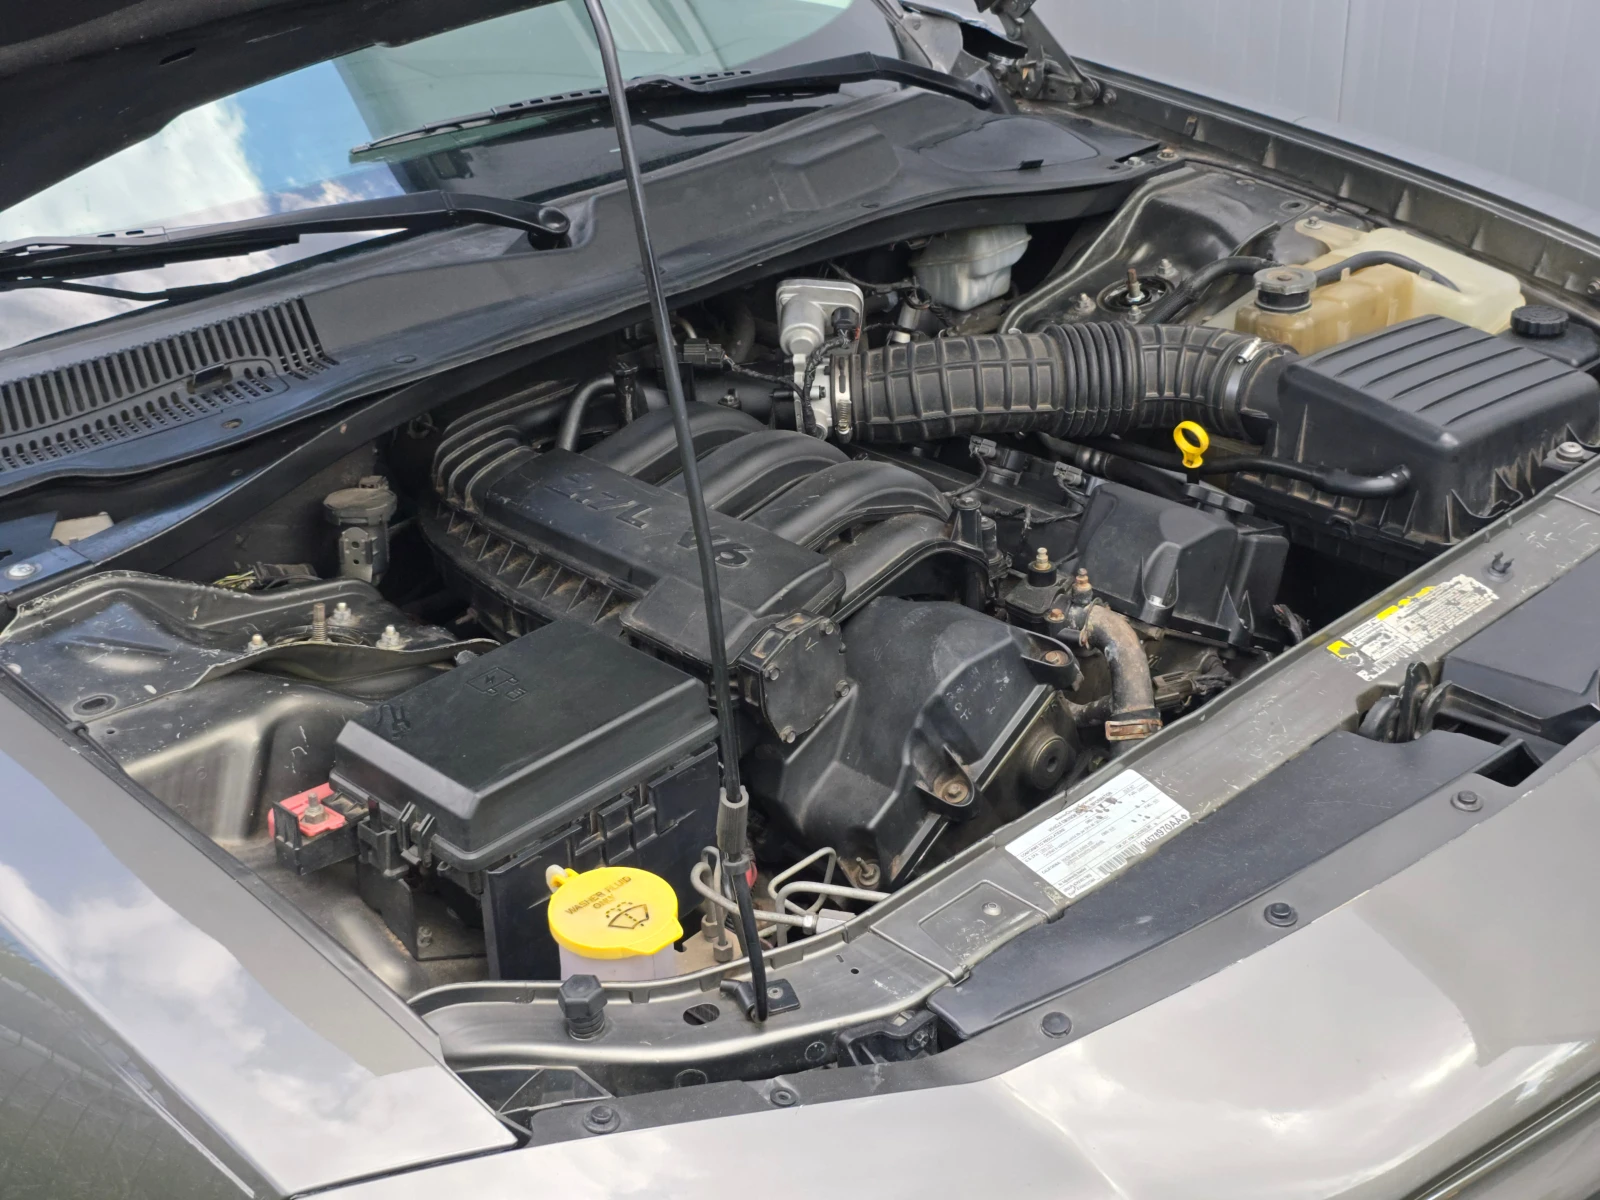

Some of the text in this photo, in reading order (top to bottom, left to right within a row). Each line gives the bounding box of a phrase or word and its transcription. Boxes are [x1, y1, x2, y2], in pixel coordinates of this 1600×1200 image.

[1140, 817, 1182, 847] 04578970AA
[565, 876, 632, 915] WASHER FLUID
